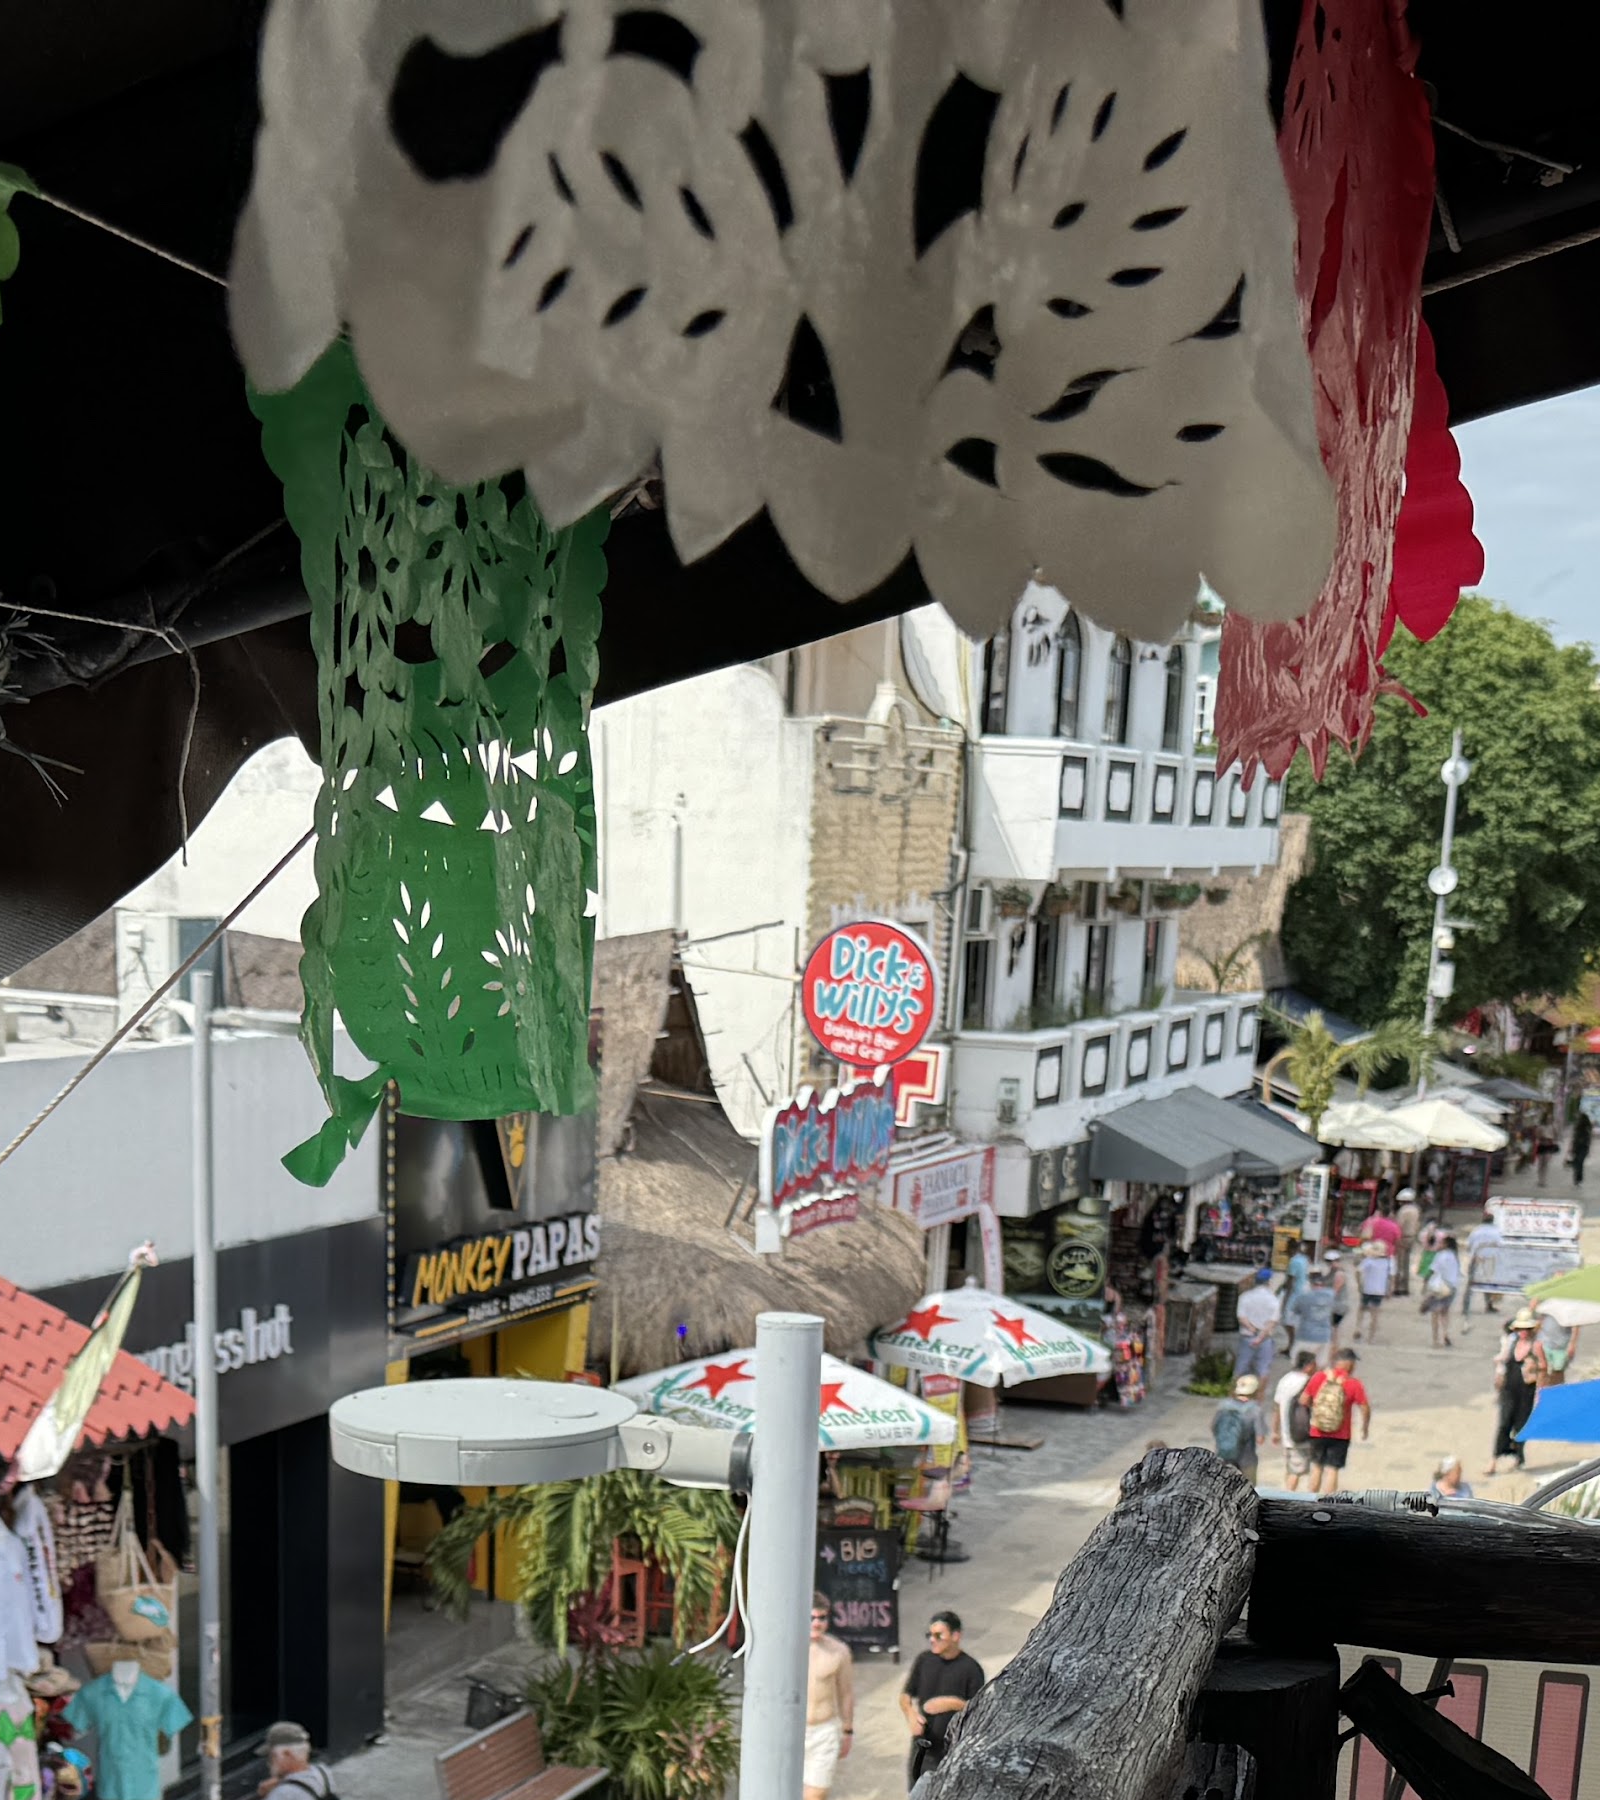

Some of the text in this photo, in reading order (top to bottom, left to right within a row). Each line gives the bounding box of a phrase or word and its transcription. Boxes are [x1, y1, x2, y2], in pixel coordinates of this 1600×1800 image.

[832, 935, 926, 990] Dick &
[815, 979, 922, 1034] Willy's
[412, 1214, 602, 1310] MONKEY PAPAS
[876, 1331, 975, 1360] eineken
[907, 1351, 961, 1369] SILVER
[818, 1406, 915, 1427] eineken
[863, 1426, 914, 1440] SILVER
[833, 1599, 893, 1628] SHOTS
